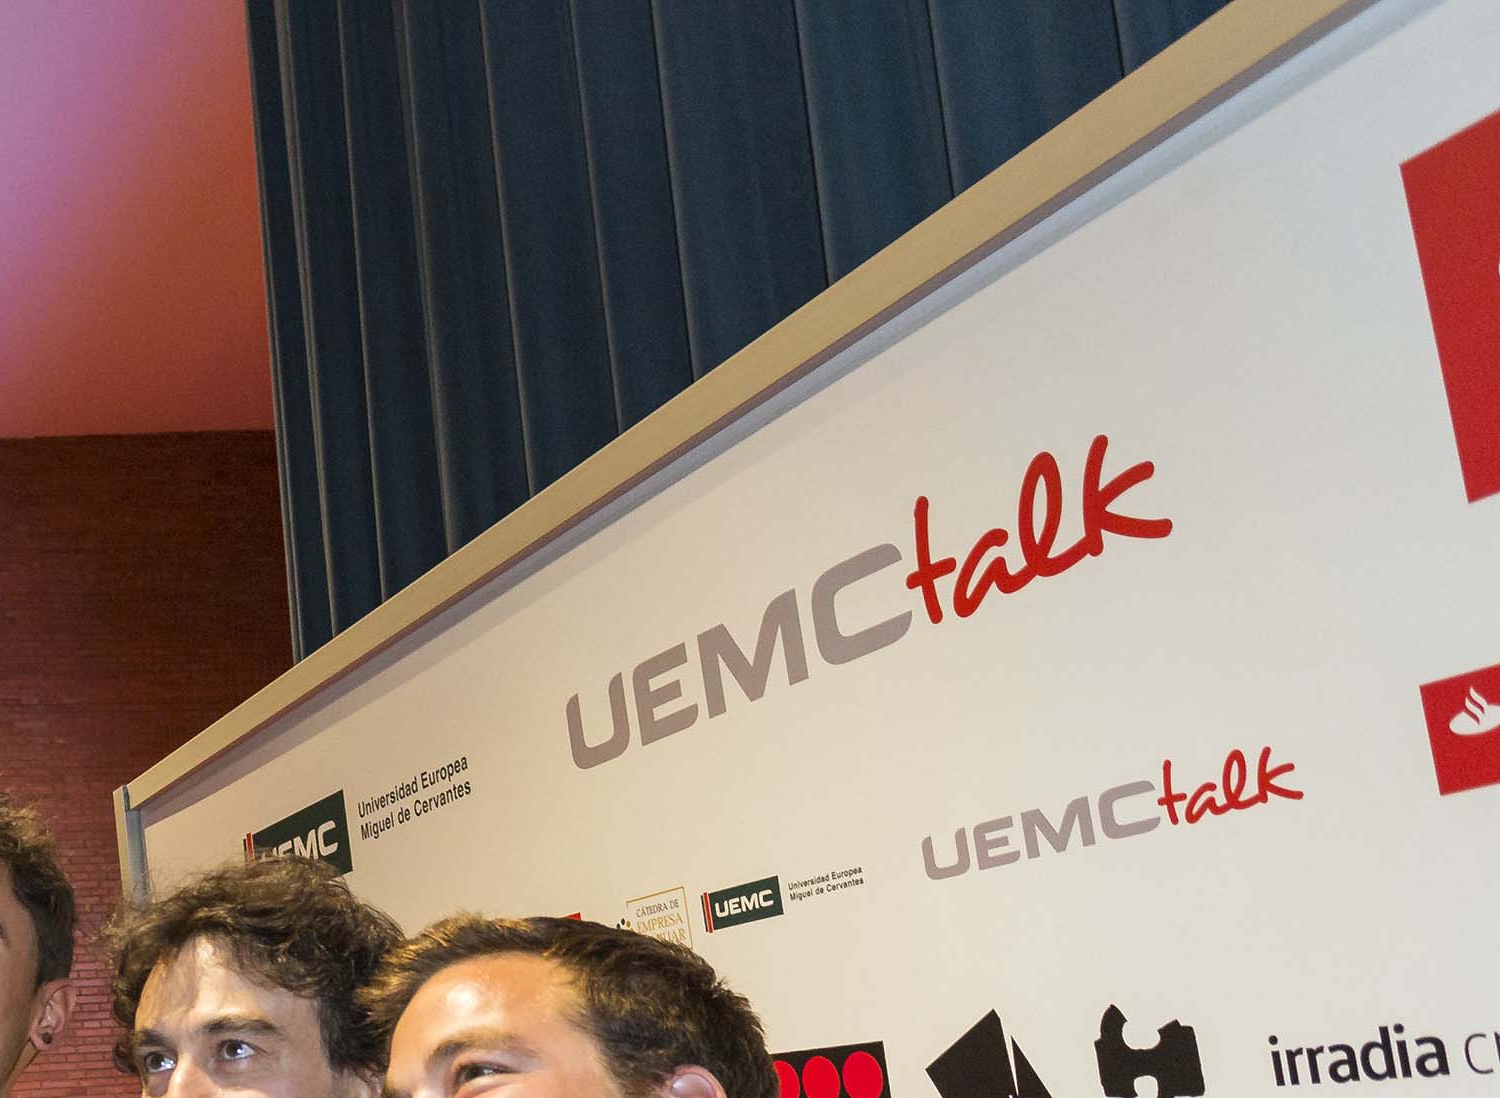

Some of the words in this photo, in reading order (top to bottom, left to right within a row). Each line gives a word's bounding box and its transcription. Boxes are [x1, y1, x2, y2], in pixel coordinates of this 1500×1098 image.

[358, 776, 418, 818] Universidad
[420, 756, 469, 789] Europea
[360, 815, 394, 841] Miguel
[398, 806, 411, 824] de
[414, 780, 472, 817] Cervantes
[263, 820, 339, 861] EMC
[787, 873, 830, 891] Universidad
[831, 866, 863, 880] Europea
[789, 889, 814, 902] Miguel
[816, 886, 825, 895] de
[826, 877, 864, 893] Cervantes
[669, 898, 680, 910] DE
[715, 889, 774, 918] UEMC
[636, 912, 684, 933] EMPRESA
[1268, 1023, 1451, 1087] irradia
[1464, 1031, 1500, 1075] C
